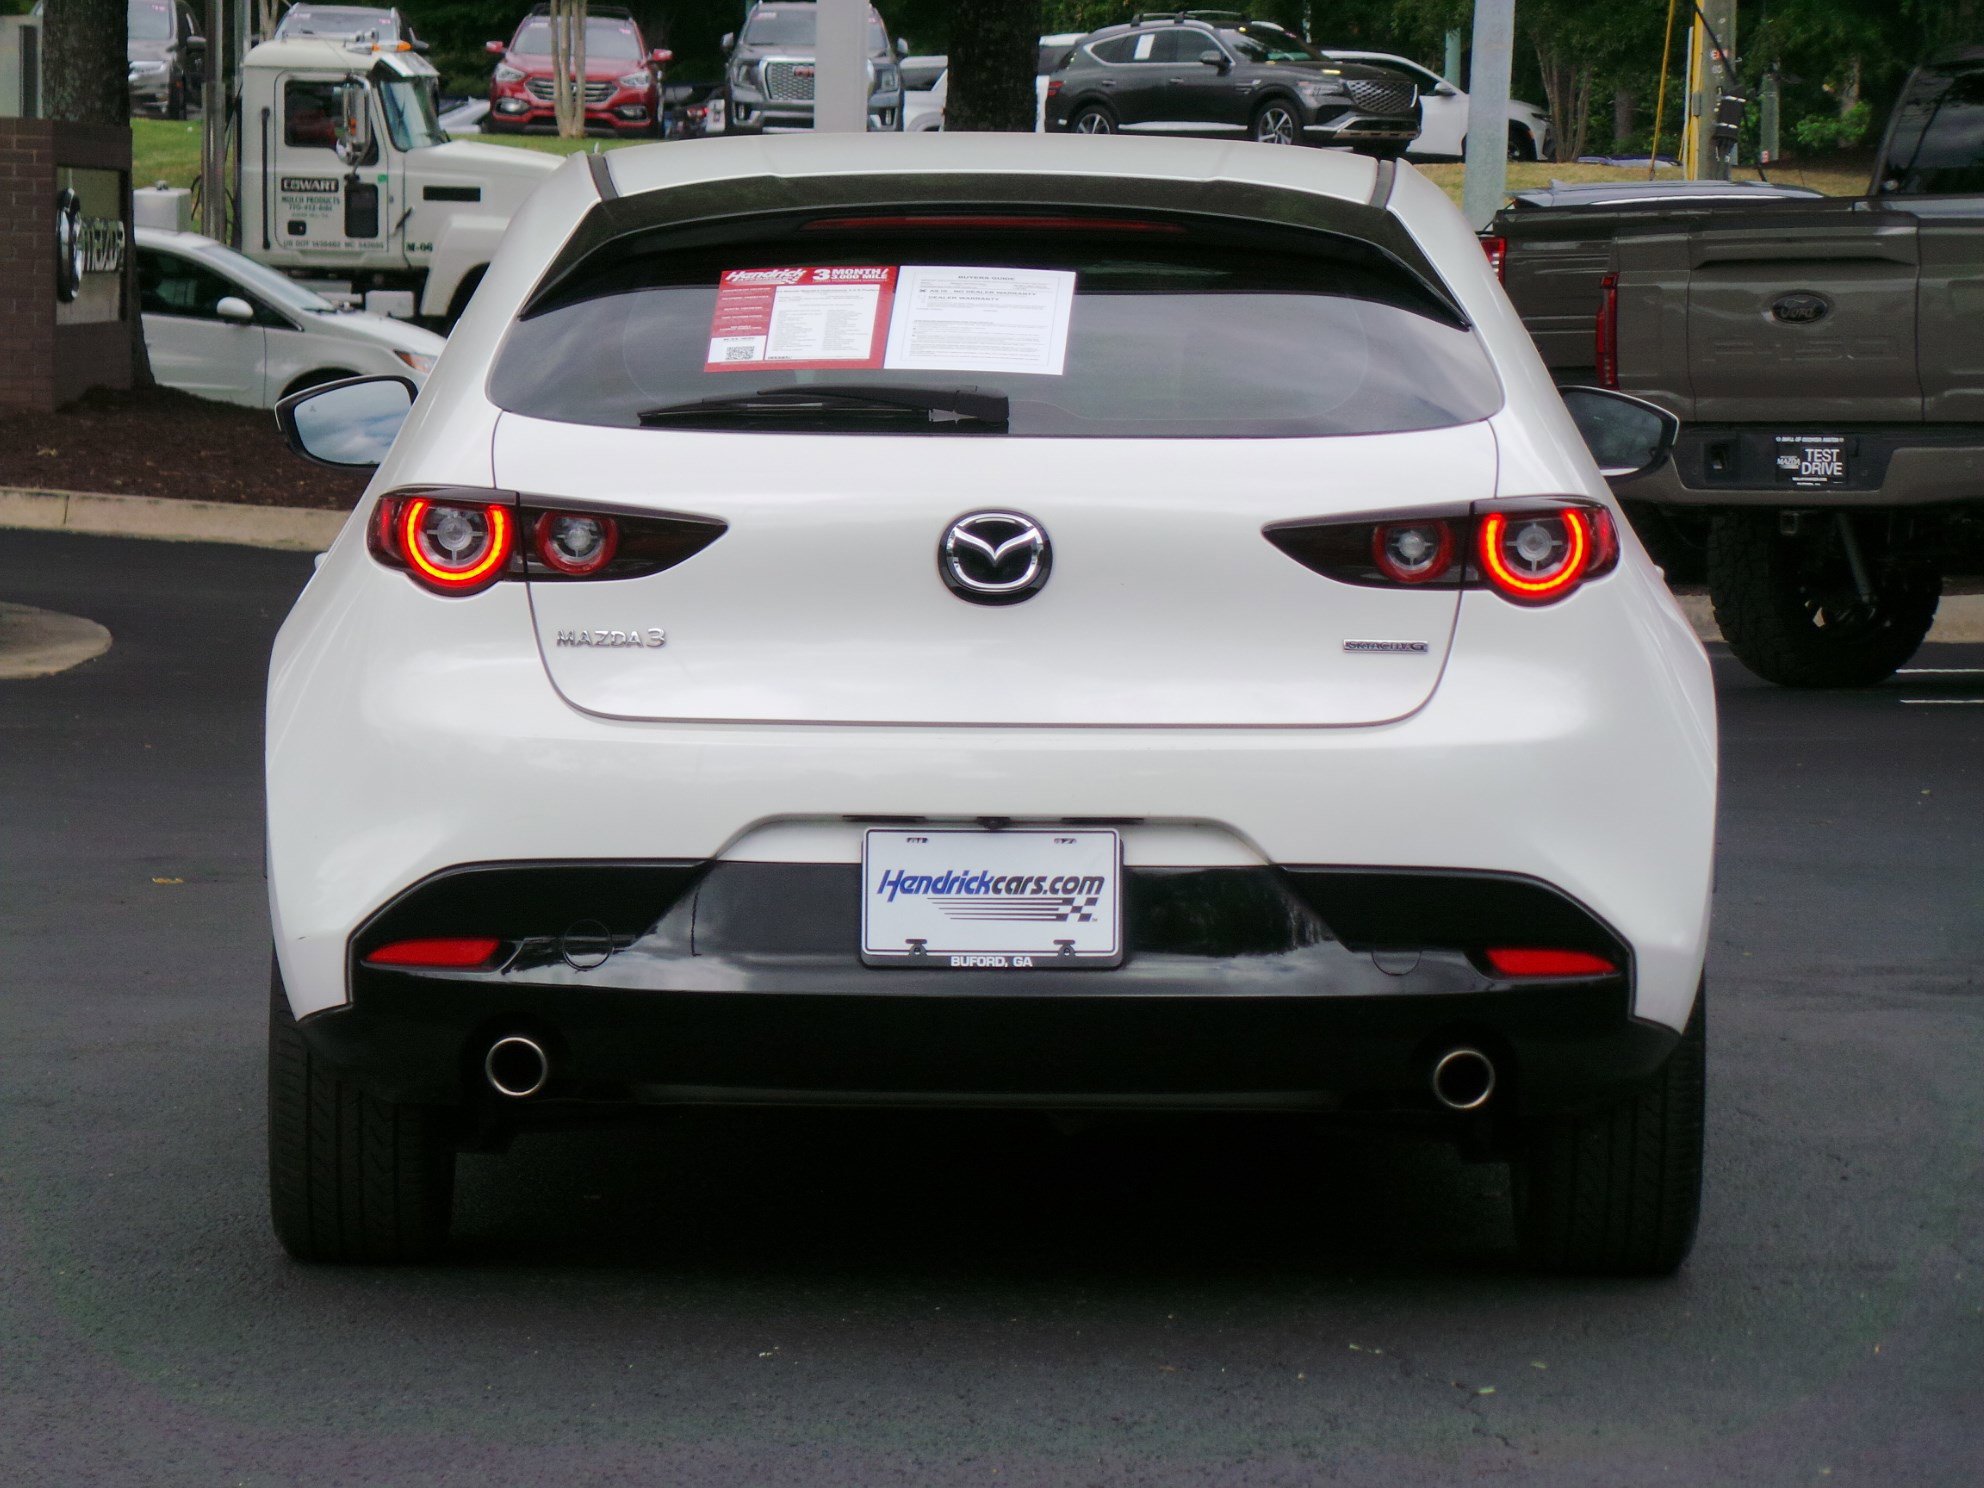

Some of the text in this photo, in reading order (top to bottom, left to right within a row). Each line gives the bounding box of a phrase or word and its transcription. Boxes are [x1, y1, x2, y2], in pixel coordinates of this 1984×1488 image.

[284, 179, 336, 191] COWART
[725, 268, 807, 282] Hendrick
[812, 268, 831, 280] 3
[1804, 448, 1840, 462] TEST
[1801, 461, 1843, 475] DRIVE
[877, 869, 1105, 903] Hendrickcars.com
[950, 956, 1033, 968] BUFORD, GA
